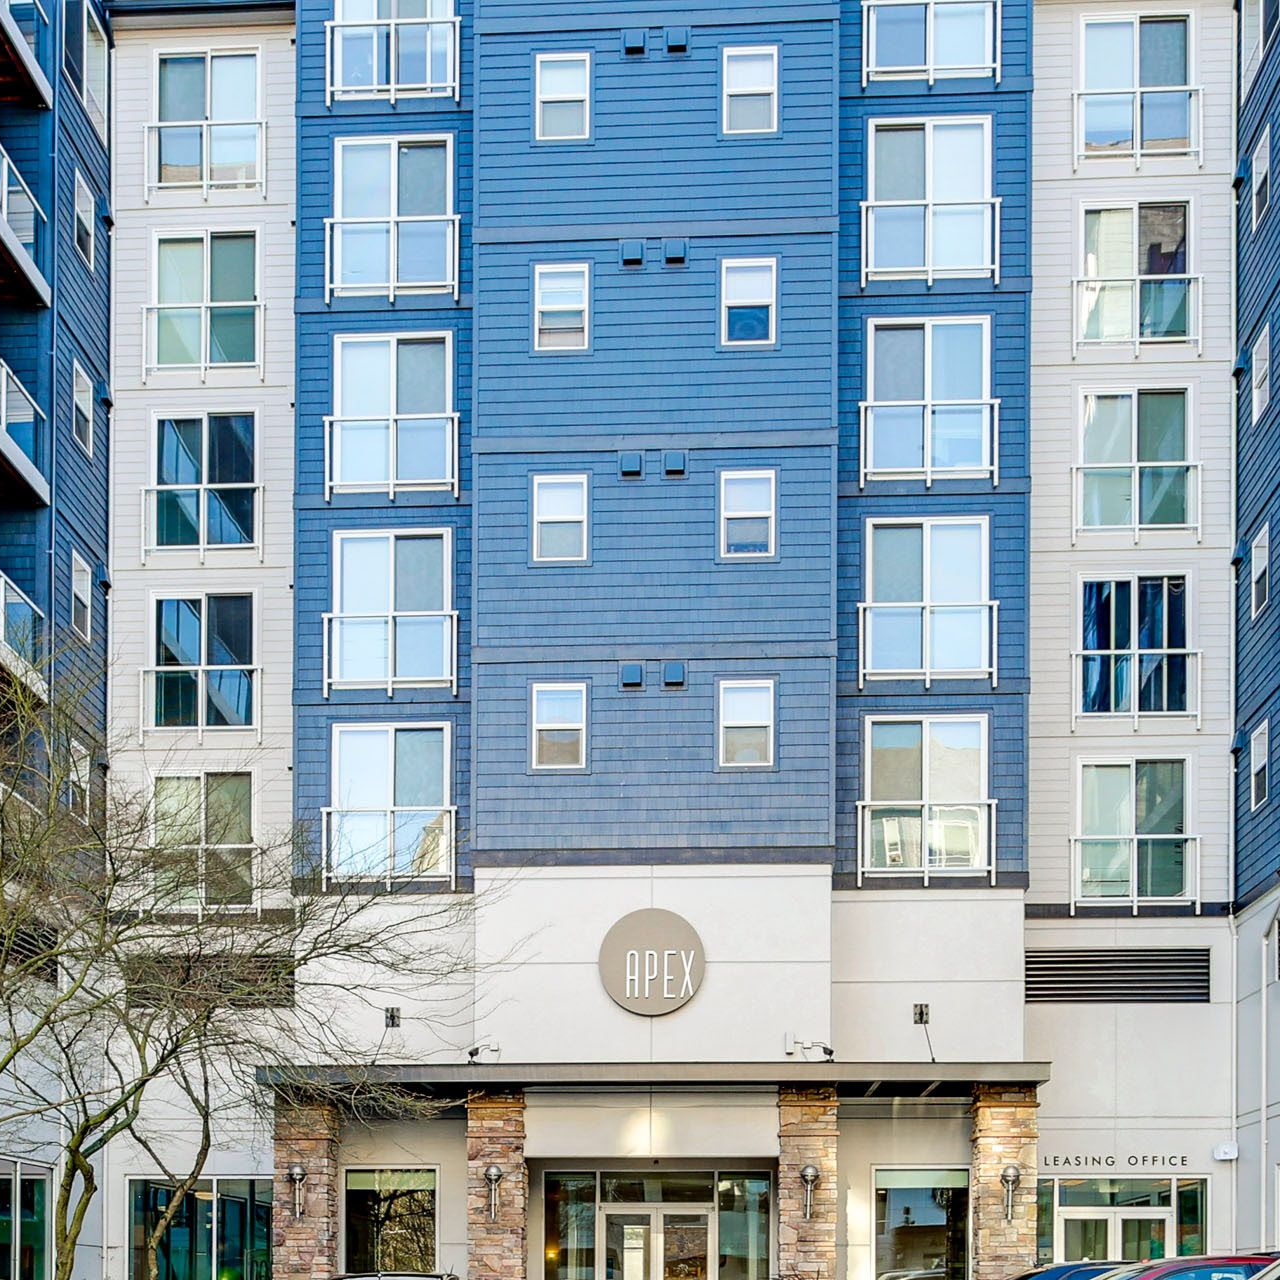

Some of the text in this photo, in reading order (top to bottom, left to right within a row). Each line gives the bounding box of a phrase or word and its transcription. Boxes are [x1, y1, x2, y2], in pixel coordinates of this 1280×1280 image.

[626, 950, 695, 999] APEX
[1044, 1155, 1188, 1166] LEASING OFFICE
